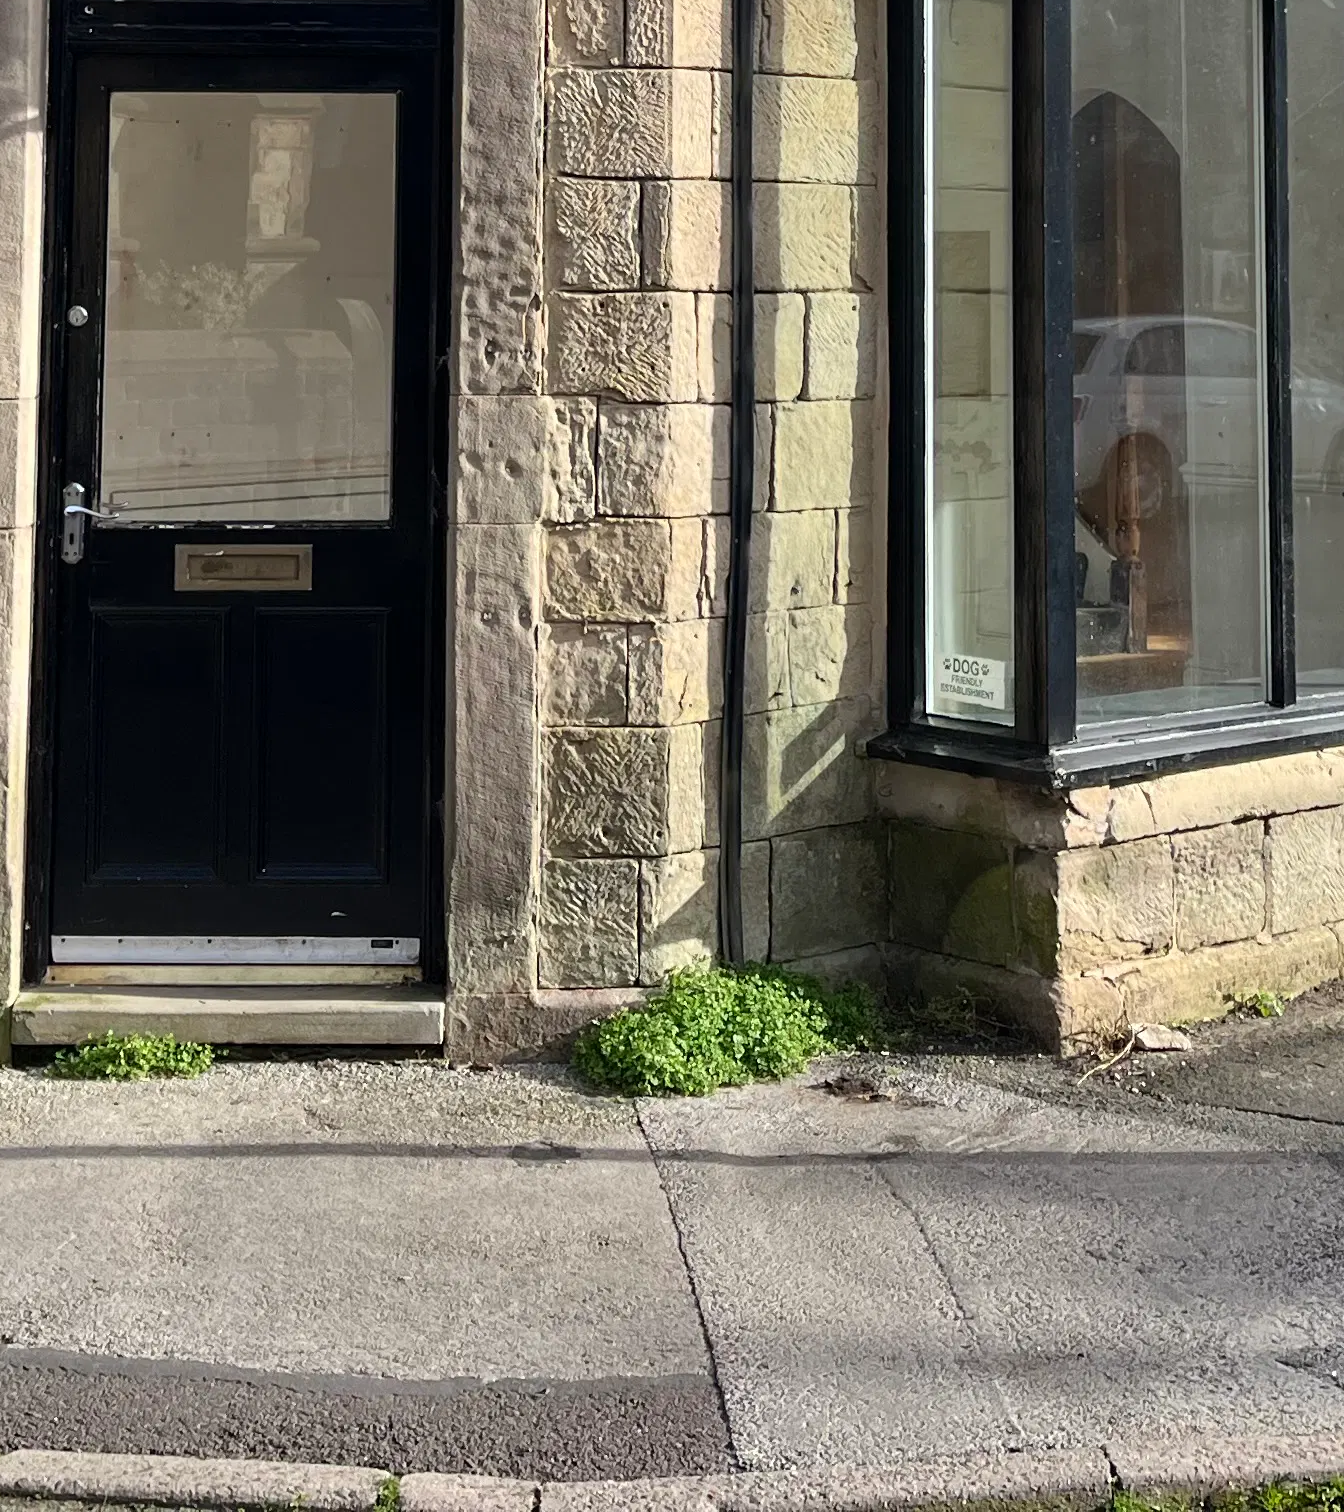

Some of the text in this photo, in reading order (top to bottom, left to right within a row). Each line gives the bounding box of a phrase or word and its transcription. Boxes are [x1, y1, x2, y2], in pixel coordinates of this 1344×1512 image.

[953, 658, 980, 676] DOG
[951, 675, 983, 687] FRIENDLY
[940, 683, 994, 700] ESTABLISHMENT
